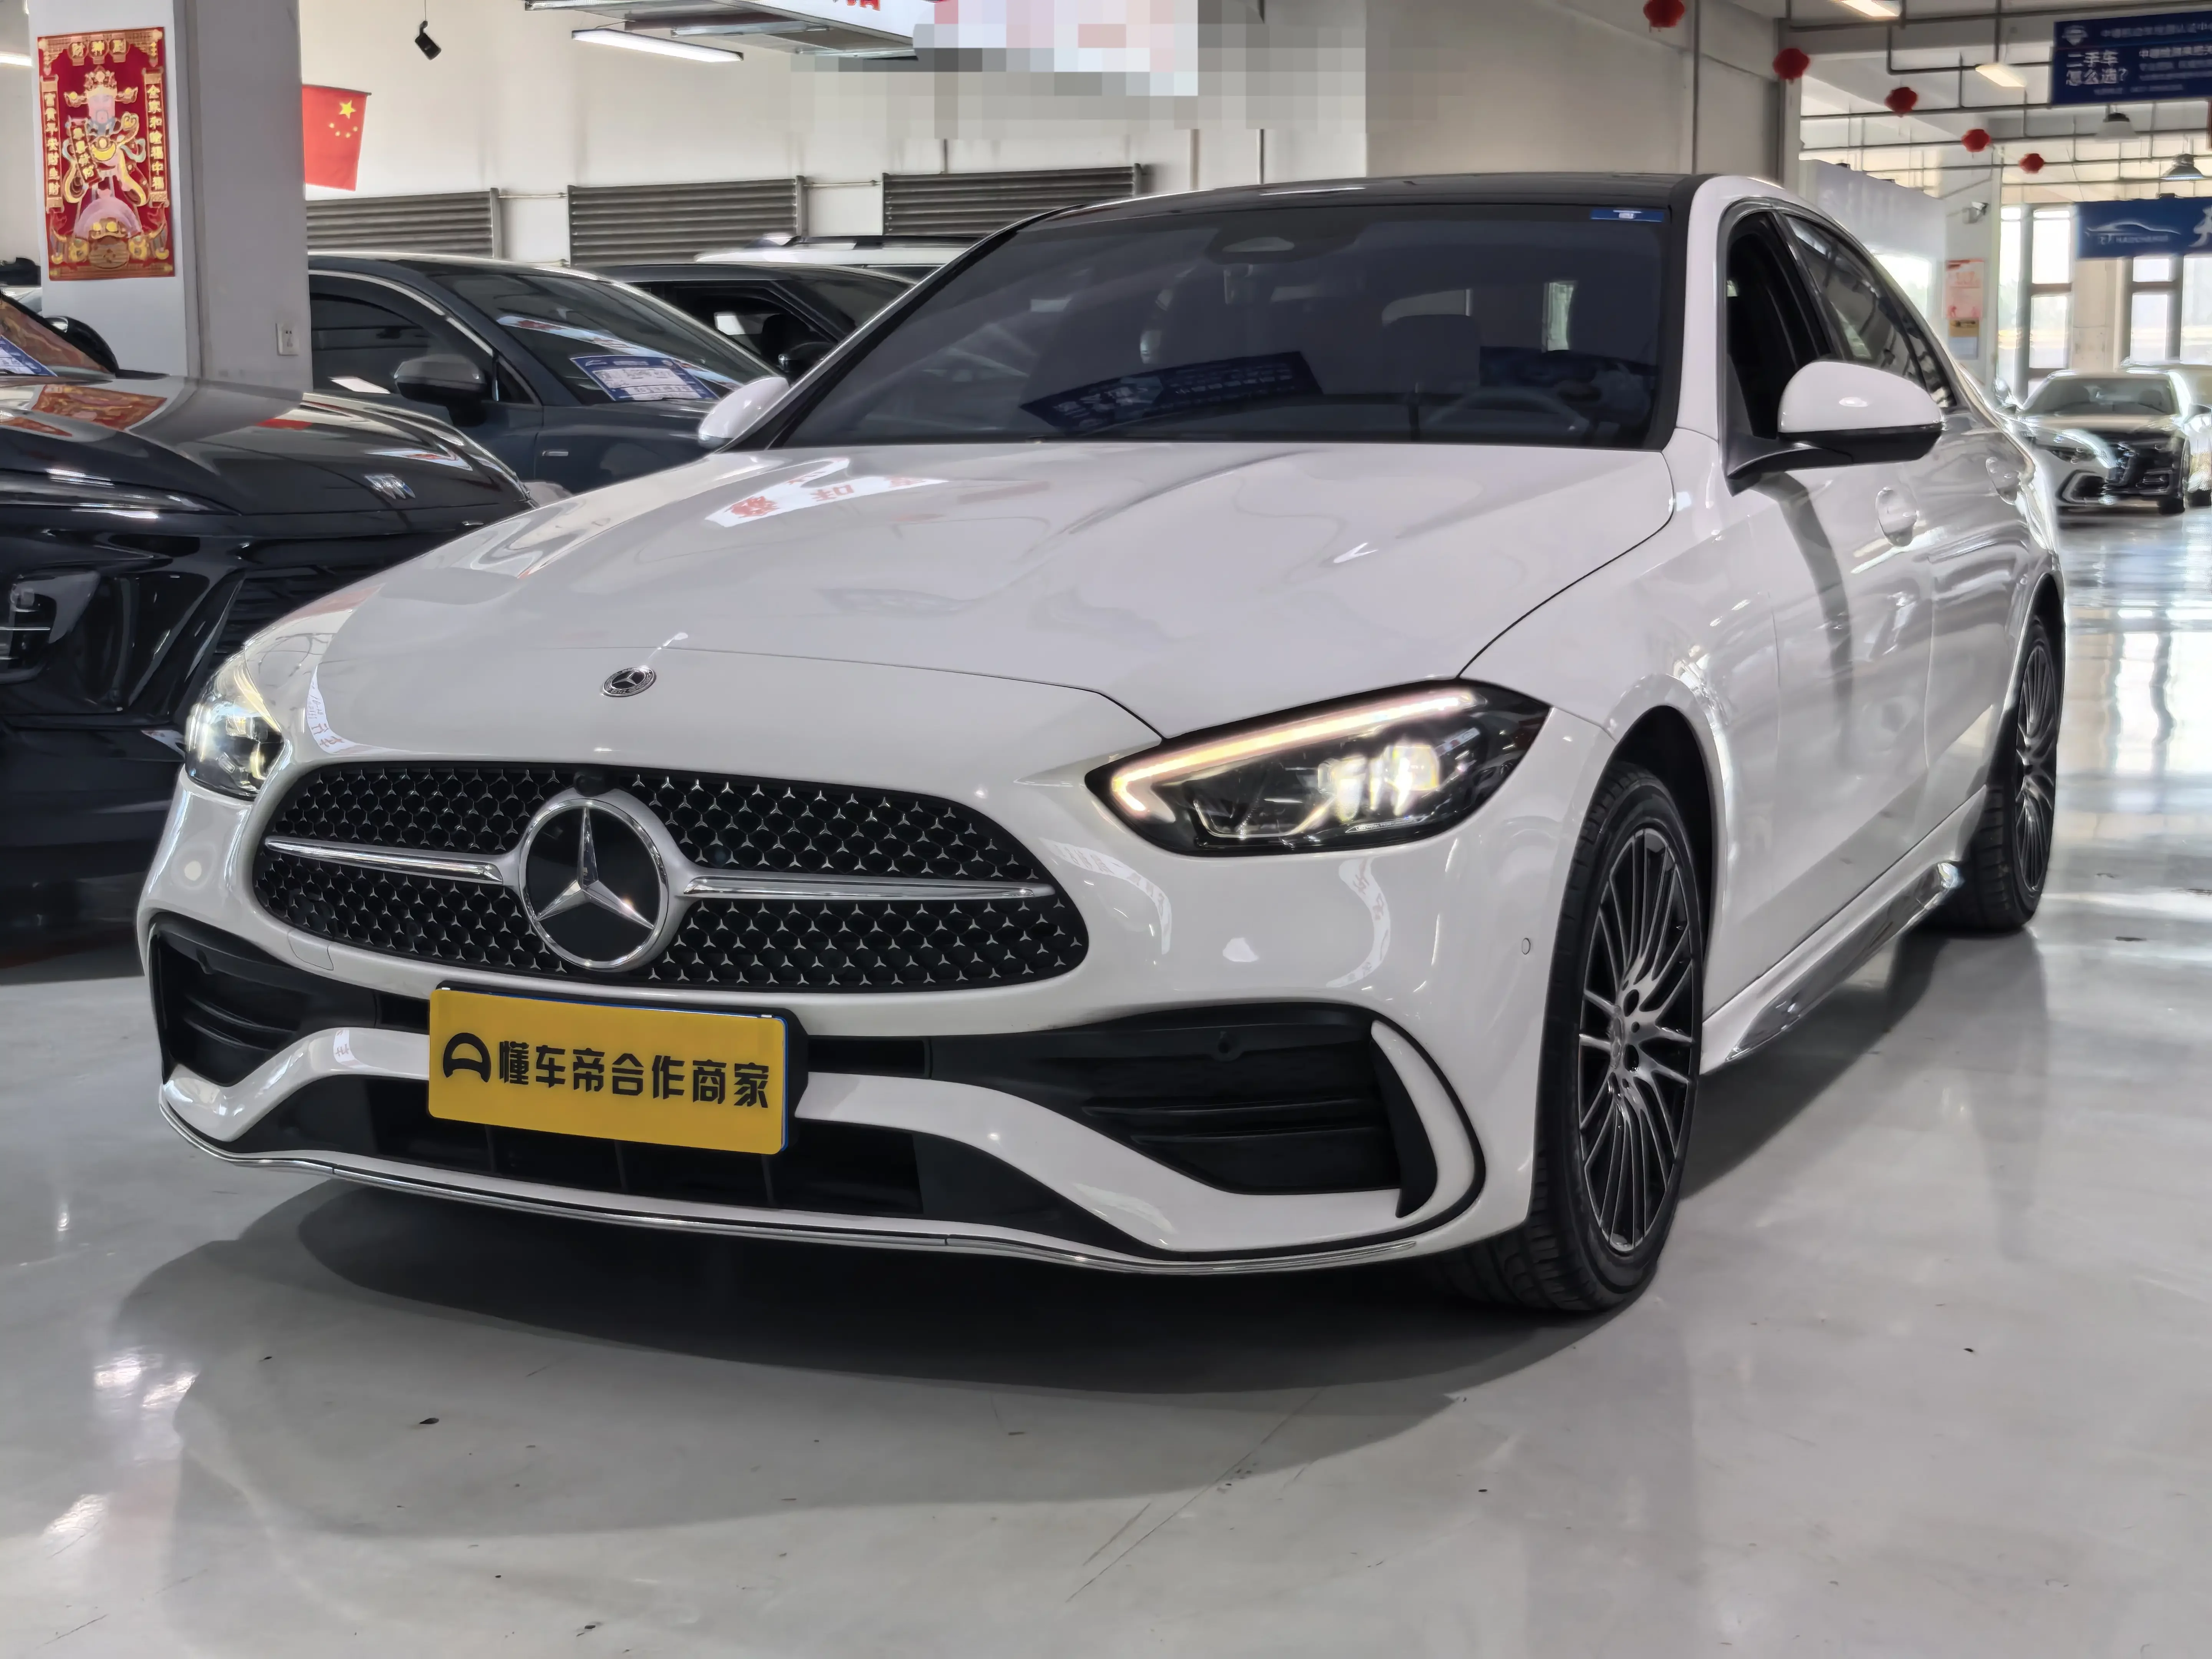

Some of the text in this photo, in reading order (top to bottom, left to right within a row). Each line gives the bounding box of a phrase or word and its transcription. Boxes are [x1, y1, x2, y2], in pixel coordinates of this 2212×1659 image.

[2066, 50, 2119, 67] 二手车
[498, 1041, 770, 1108] 懂车帝合作商家
